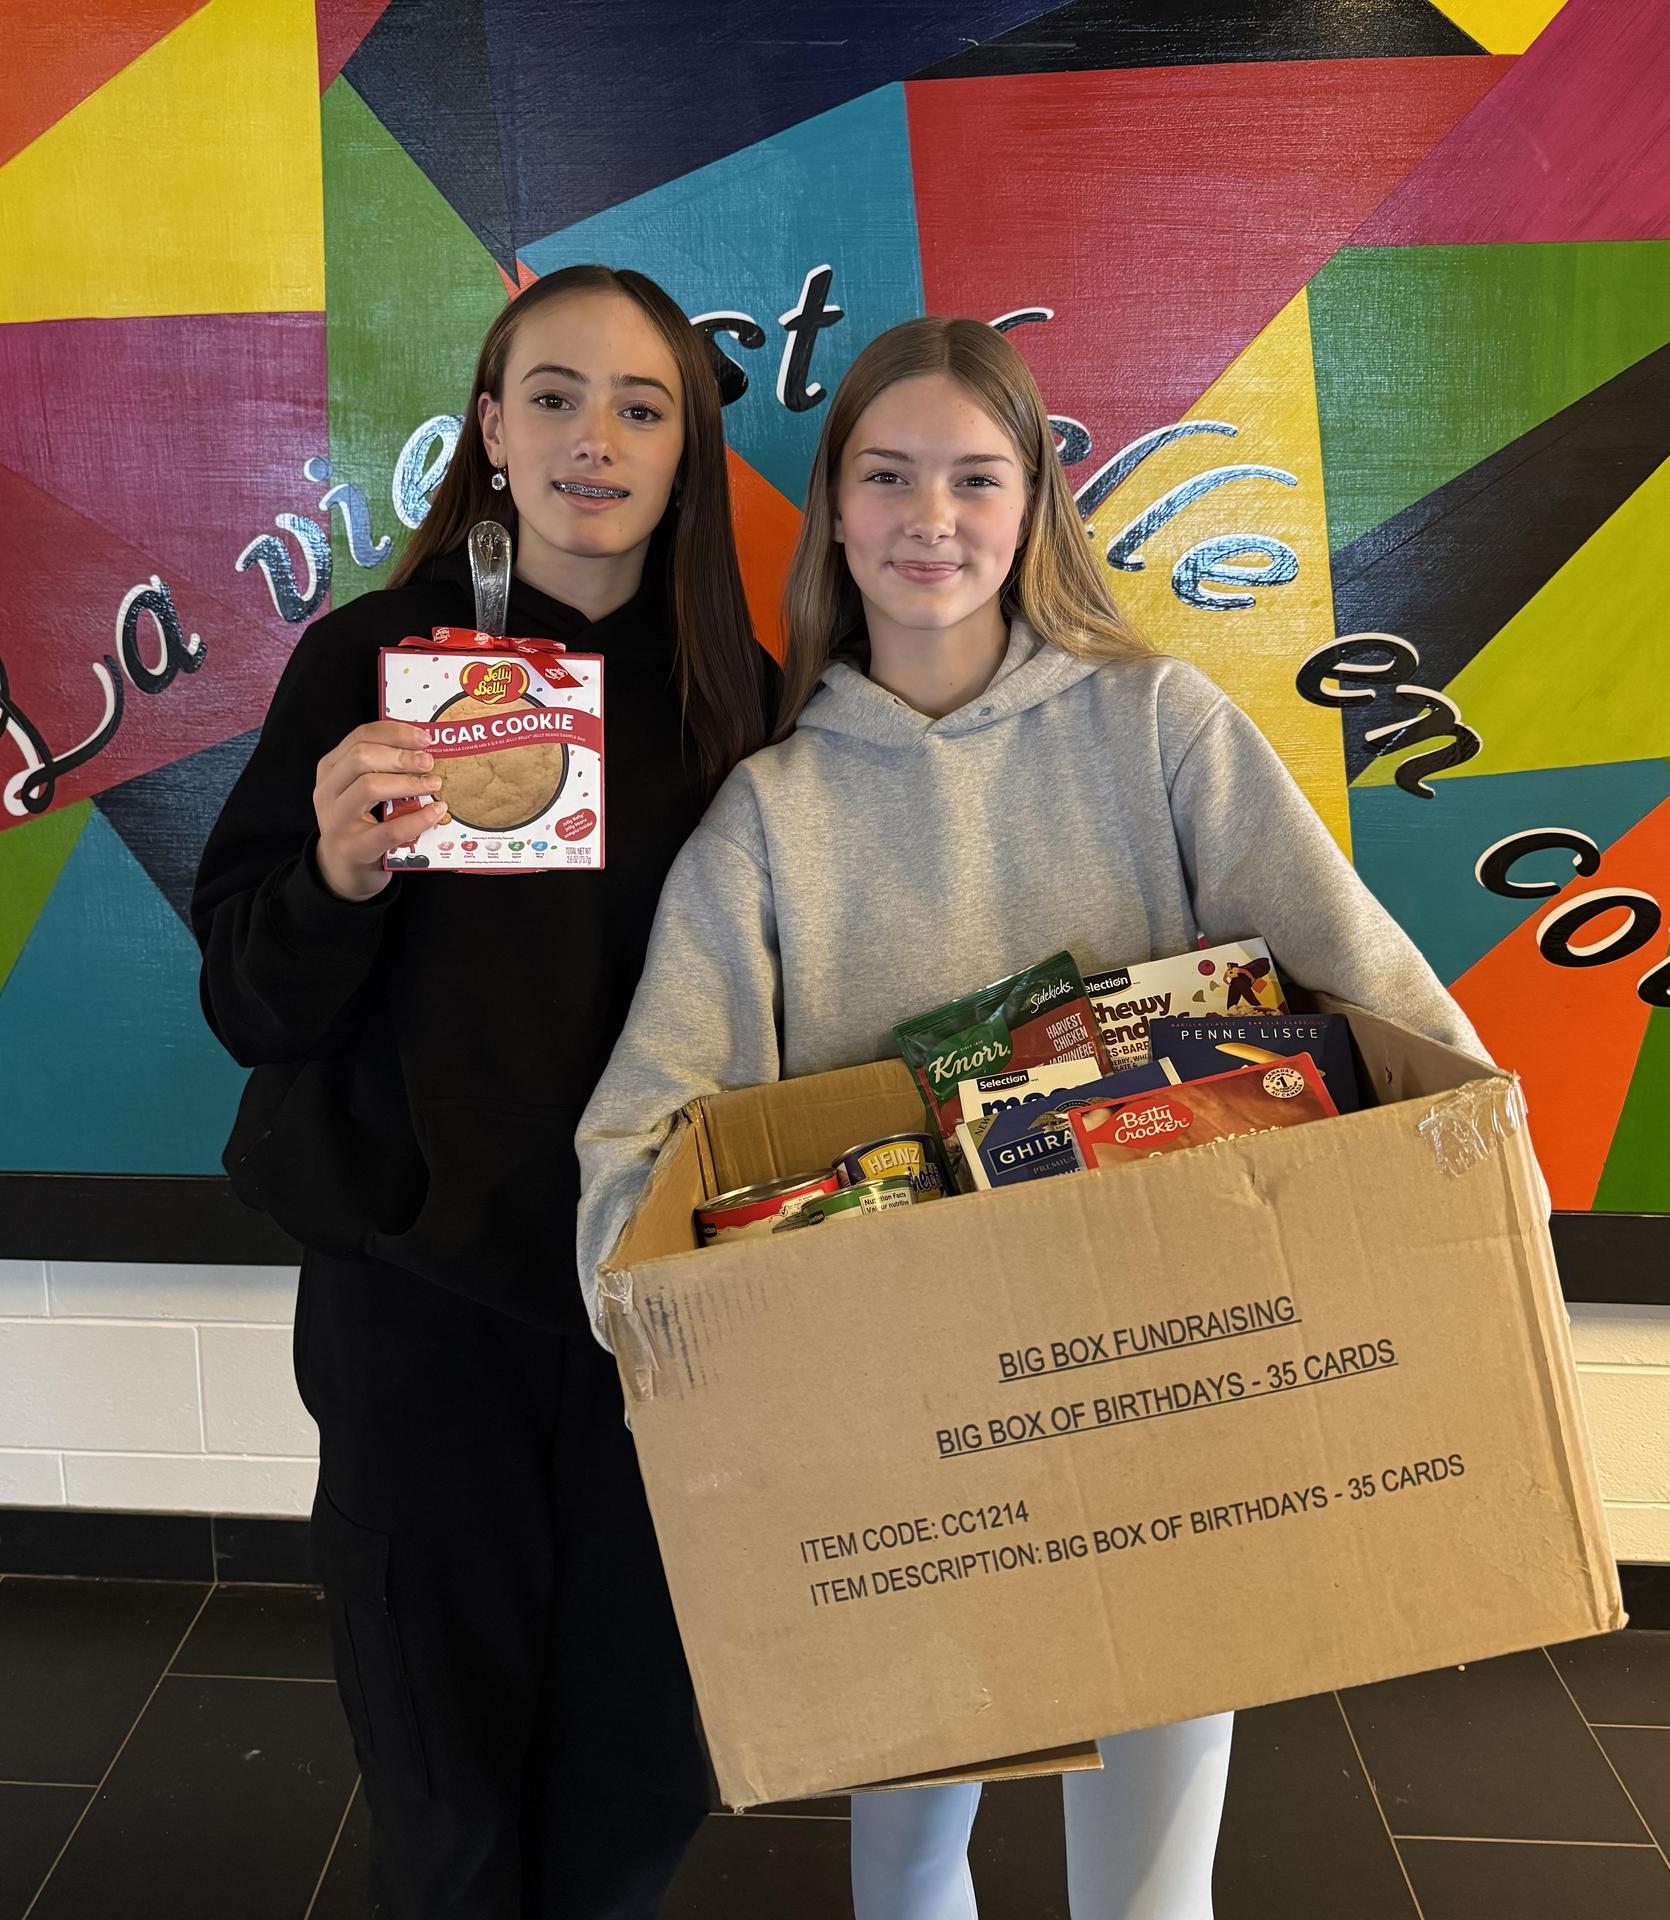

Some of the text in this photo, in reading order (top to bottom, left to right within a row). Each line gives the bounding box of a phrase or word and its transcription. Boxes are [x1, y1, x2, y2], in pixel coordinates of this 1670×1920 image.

[235, 414, 465, 623] vie
[689, 264, 845, 413] st
[1295, 632, 1483, 799] en
[1475, 827, 1670, 1008] co
[483, 666, 512, 684] Jelly
[473, 680, 507, 698] Belly
[425, 713, 574, 745] UGAR COOKIE
[1030, 979, 1074, 1014] Sidekicks
[1085, 975, 1129, 994] election
[1046, 1012, 1083, 1040] HARVEST
[1053, 1026, 1089, 1053] CHICKEN
[1181, 1027, 1319, 1040] PENNE LISCE
[928, 1039, 1009, 1083] Knorr
[979, 1073, 1027, 1090] Selection
[1281, 1083, 1303, 1098] CANADA
[974, 1116, 991, 1137] NEW
[1115, 1104, 1174, 1129] Betty
[1115, 1117, 1190, 1144] Crocker
[1000, 1129, 1074, 1165] GHIRA
[868, 1147, 920, 1176] HEINZ
[892, 1191, 907, 1200] Facts
[999, 1295, 1295, 1378] BIG BOX FUNDRAISING
[936, 1424, 982, 1455] BIG
[988, 1411, 1046, 1445] BOX
[1051, 1402, 1086, 1432] OF
[1094, 1372, 1246, 1425] BIRTHDAYS
[1268, 1361, 1297, 1389] 35
[1303, 1339, 1396, 1381] CARDS
[801, 1500, 1030, 1563] ITEM CODE: CC1214
[810, 1575, 868, 1606] ITEM
[872, 1543, 1042, 1595] DESCRIPTION:
[1045, 1534, 1089, 1563] BIG
[1093, 1523, 1147, 1554] BOX
[1151, 1515, 1184, 1542] OF
[1190, 1486, 1329, 1535] BIRTHDAYS
[1347, 1474, 1377, 1501] 35
[1381, 1453, 1465, 1492] CARDS
